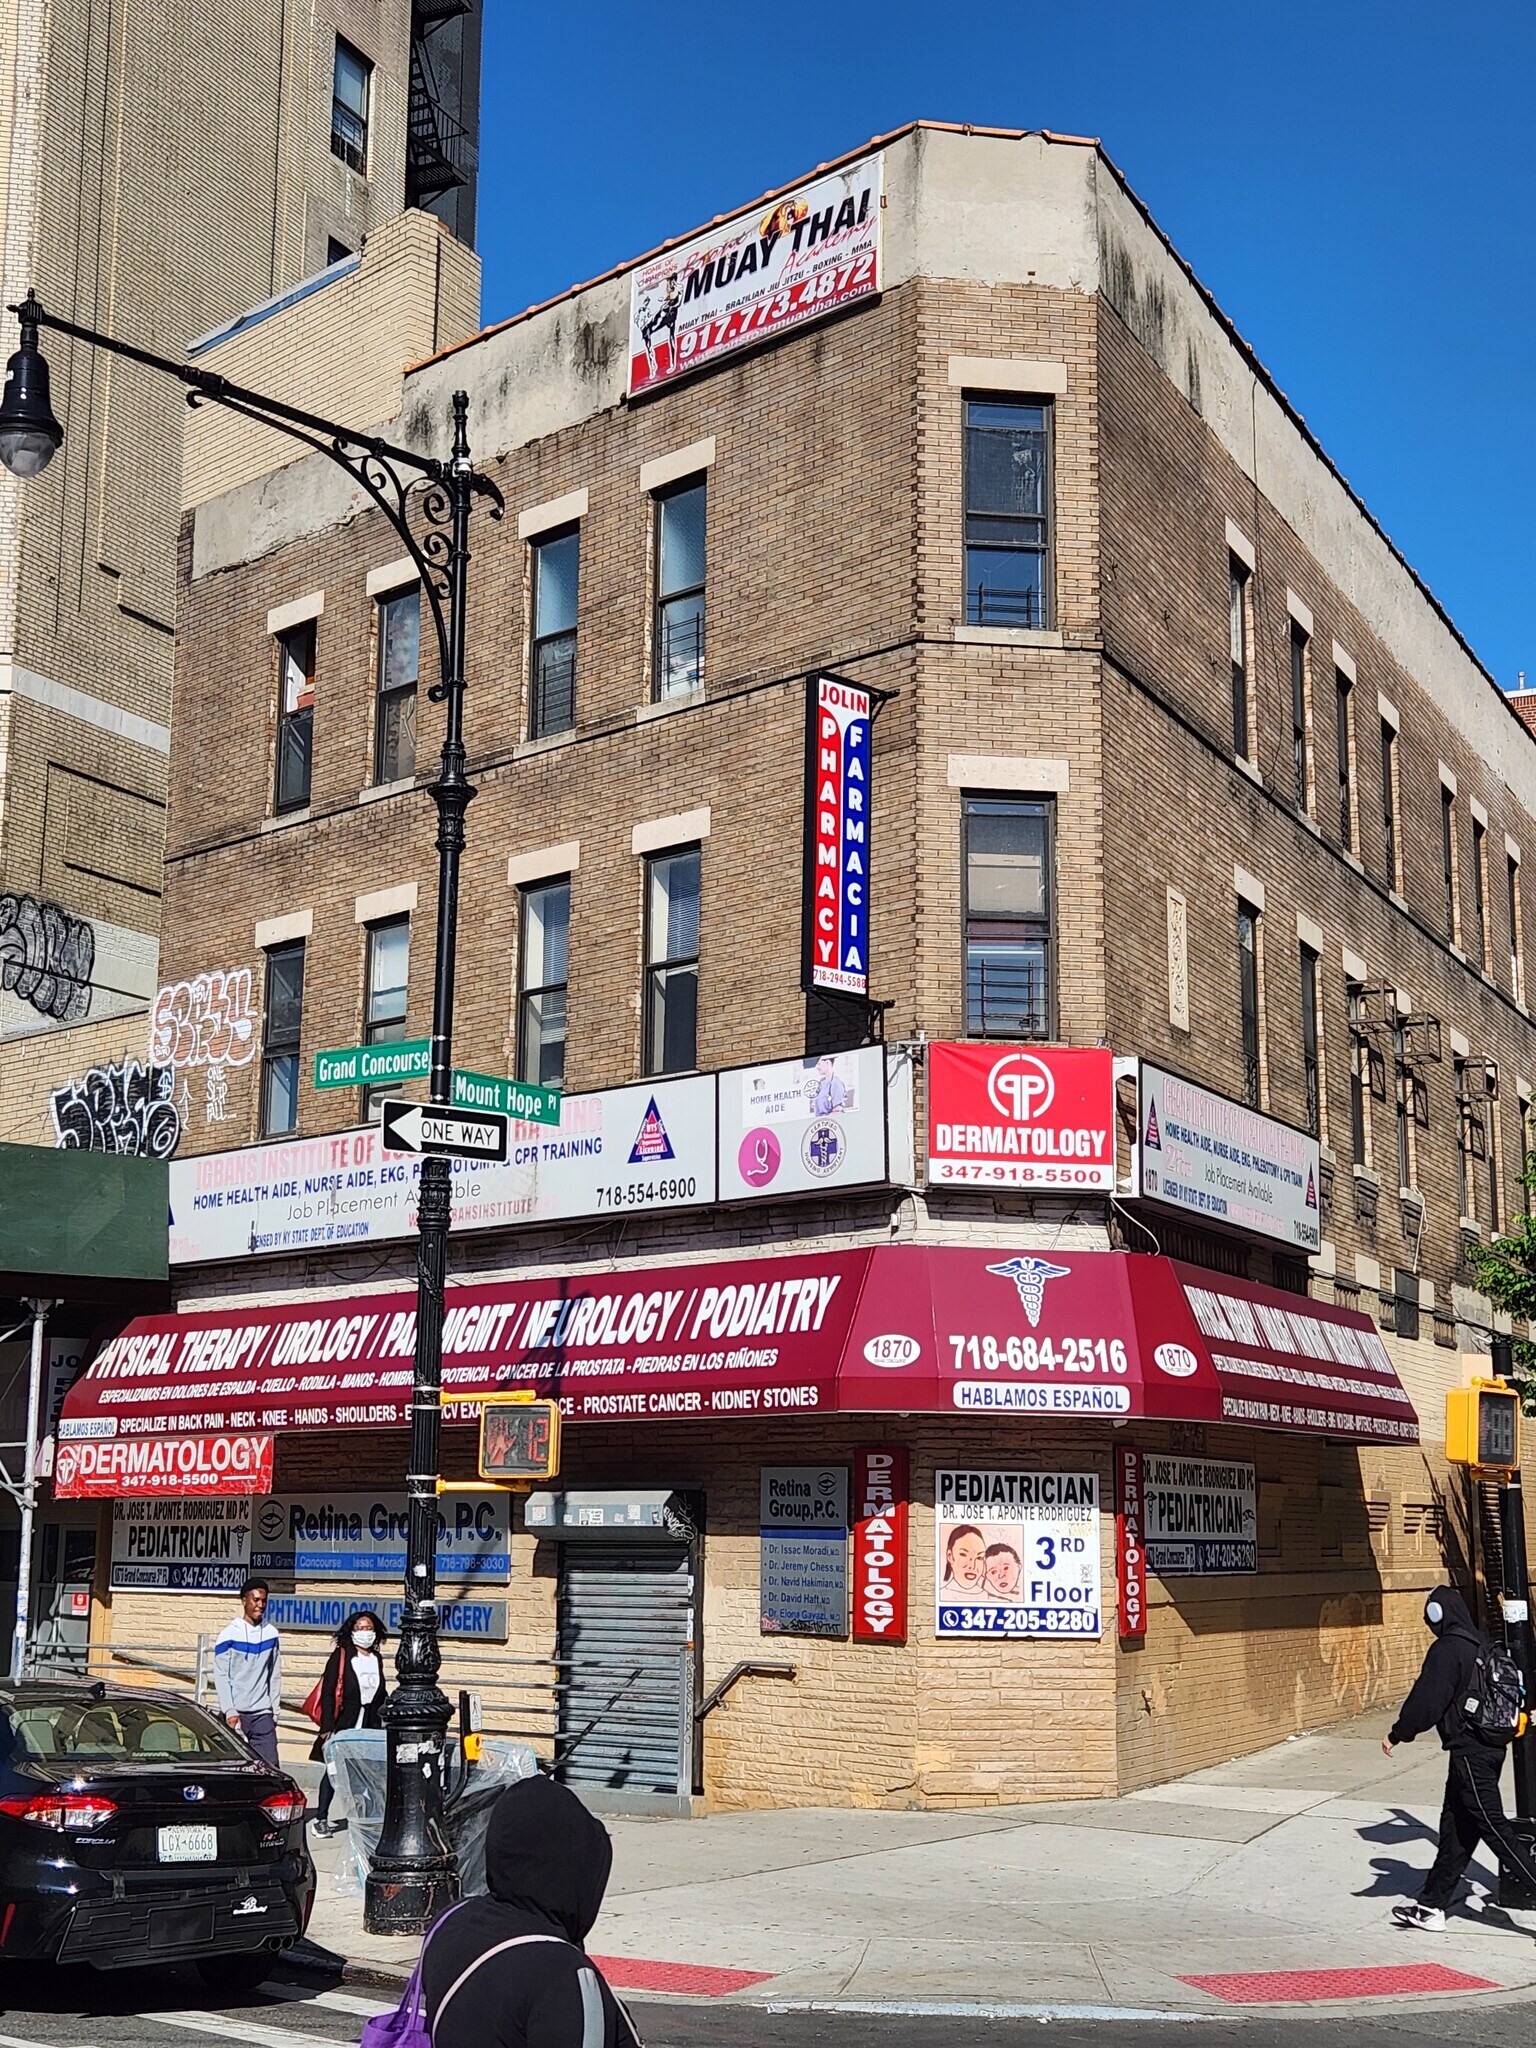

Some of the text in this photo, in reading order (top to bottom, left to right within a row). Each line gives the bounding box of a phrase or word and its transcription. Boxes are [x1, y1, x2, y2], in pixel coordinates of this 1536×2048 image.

[684, 187, 871, 304] MUAY THAI
[779, 215, 877, 280] Academy
[637, 264, 678, 288] CHAMPIONS
[642, 258, 673, 277] HOME OF
[678, 239, 872, 332] MUAY THAI BRAZILIAN JIU JITZU BOXING MMA
[679, 252, 876, 359] 917.773.4872
[820, 682, 868, 715] JOLIN
[817, 716, 838, 965] PHARMACY
[845, 724, 864, 972] FARMACIA
[318, 1049, 430, 1083] Grand Concourse
[456, 1076, 557, 1119] Mount Hope Pl
[750, 1094, 772, 1106] HOME
[774, 1089, 802, 1102] HEALTH
[765, 1103, 786, 1115] AIDE
[421, 1120, 496, 1147] ONE WAY
[810, 1120, 838, 1135] CERTIFIED
[936, 1123, 1107, 1157] DERMATOLOGY
[1165, 1120, 1180, 1141] HOME
[1181, 1125, 1200, 1148] HEALTH
[193, 1191, 224, 1211] HOME
[226, 1185, 270, 1206] HEALTH
[271, 1181, 302, 1200] AIDE,
[304, 1174, 343, 1195] NURSE
[346, 1169, 377, 1189] AIDE,
[380, 1164, 409, 1185] EKG,
[515, 1144, 539, 1164] CPR
[542, 1136, 602, 1161] TRAINING
[261, 1137, 350, 1186] INSTITUTE
[353, 1133, 377, 1167] OF
[941, 1164, 1102, 1183] 347-918-5500
[596, 1176, 697, 1208] 718-554-6900
[1204, 1162, 1215, 1184] Job
[1216, 1167, 1248, 1196] Placement
[1249, 1181, 1274, 1205] Available
[286, 1191, 399, 1221] Job Placement
[274, 1220, 370, 1246] BY NY STATE DEPT. OF EDUCATION
[86, 1275, 842, 1380] PHYSICAL THERAPY UROLOGY MGMT NEUROLOGY PODIATRY
[871, 1339, 912, 1359] 1870
[949, 1335, 1128, 1374] 718-684-2516
[1159, 1347, 1192, 1369] 1870
[97, 1346, 779, 1405] ESPECIALIZAMOS EN DOLORES DE ESPALDA CUELLO RODILLA MANOS CANCER DE LA PROSTATA PIEDRAS EN LOS RIÑONES
[120, 1415, 168, 1434] SPECIALIZE
[168, 1415, 178, 1431] IN
[178, 1413, 202, 1431] BACK
[204, 1412, 224, 1430] PAIN
[230, 1410, 256, 1428] NECK
[262, 1408, 288, 1426] KNEE
[294, 1406, 328, 1425] HANDS
[335, 1404, 397, 1424] SHOULDERS
[583, 1394, 647, 1415] PROSTATE
[649, 1392, 702, 1413] CANCER
[711, 1389, 762, 1410] KIDNEY
[763, 1385, 819, 1407] STONES
[961, 1385, 1124, 1409] HABLAMOS ESPAÑOL
[90, 1418, 115, 1436] ESPAÑOL
[79, 1436, 270, 1476] DERMATOLOGY
[121, 1473, 219, 1487] 347-918-5500
[769, 1479, 811, 1497] Retina
[940, 1473, 1095, 1506] PEDIATRICIAN
[1154, 1460, 1172, 1485] JOSE
[1178, 1463, 1203, 1487] APONTE
[1203, 1465, 1237, 1490] RODRIGUEZ
[1237, 1469, 1246, 1491] MD
[1246, 1469, 1254, 1492] PC
[114, 1502, 126, 1521] DR.
[127, 1501, 145, 1521] JOSE
[153, 1500, 182, 1521] APONTE
[184, 1499, 225, 1520] RODRIGUEZ
[226, 1499, 238, 1520] MD
[239, 1499, 249, 1520] PC
[289, 1503, 363, 1542] Retina
[943, 1505, 1092, 1522] DR. JOSE APONTE RODRIGUEZ
[1158, 1491, 1244, 1534] PEDIATRICIAN
[128, 1525, 231, 1559] PEDIATRICIAN
[769, 1544, 801, 1555] Dr. Issac
[863, 1454, 896, 1633] DERMATOLOGY
[1124, 1453, 1140, 1630] DERMATOLOGY
[181, 1566, 247, 1587] 347-205-8280
[252, 1554, 505, 1571] 1870 Grand Concourse Issac 718-798-3030
[769, 1560, 808, 1574] Dr. Jeremy
[769, 1577, 780, 1587] Dr.
[1031, 1581, 1094, 1603] Floor
[769, 1592, 801, 1603] Dr. David
[768, 1608, 779, 1619] Dr.
[961, 1609, 1096, 1631] 347-205-8280
[161, 1834, 213, 1852] LGX 6668
